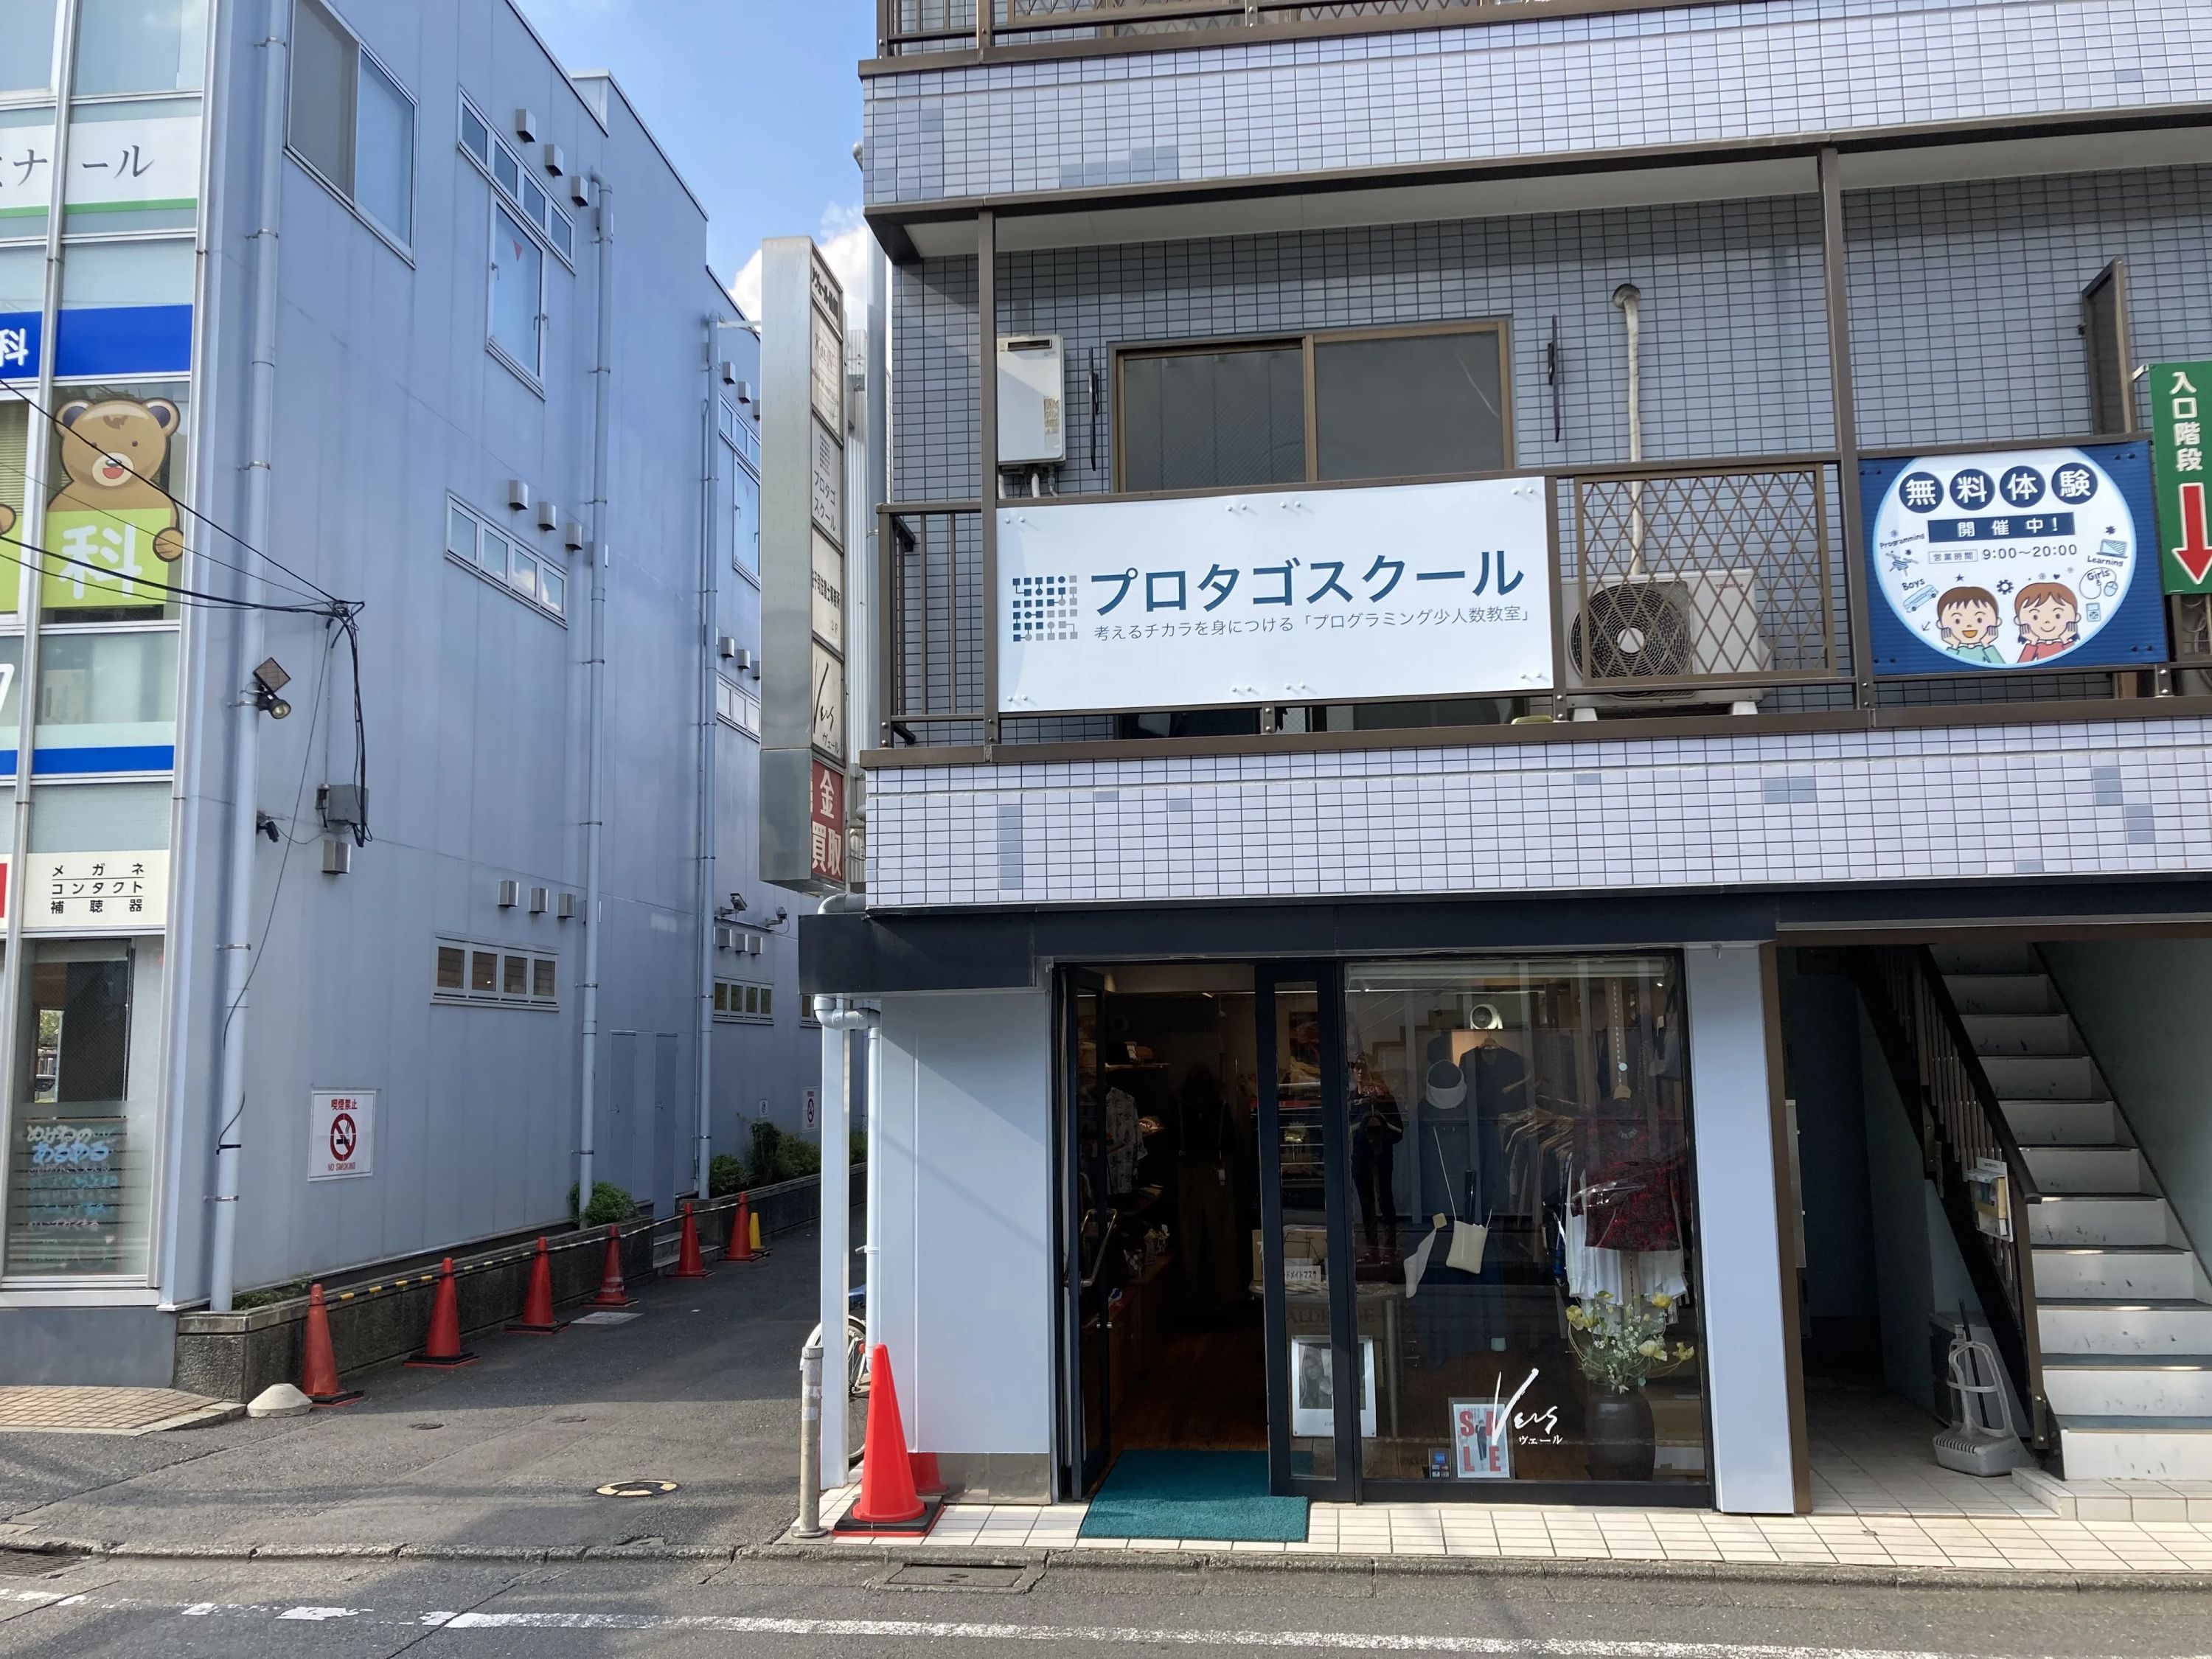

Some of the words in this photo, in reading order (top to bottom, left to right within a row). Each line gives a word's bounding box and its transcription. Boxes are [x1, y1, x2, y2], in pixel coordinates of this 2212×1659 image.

[0, 145, 155, 187] ナール
[2168, 371, 2203, 472] 入口階段
[814, 470, 835, 507] プロタゴ
[1905, 469, 2091, 507] 無料体験
[815, 496, 835, 532] スクール
[1879, 533, 1925, 549] Programming
[58, 523, 142, 599] 科
[2087, 555, 2124, 567] Learning
[1091, 550, 1526, 616] プロタゴスクール
[1902, 577, 1926, 591] Boys
[2087, 568, 2110, 581] Girls
[823, 732, 839, 754] ヴェール
[820, 769, 834, 819] 金
[812, 821, 841, 877] 買取
[52, 863, 145, 877] メガネ
[52, 881, 142, 895] コンタクト
[51, 899, 142, 914] 補聴器
[328, 1163, 335, 1171] NO
[1518, 1434, 1563, 1445] ヴェール
